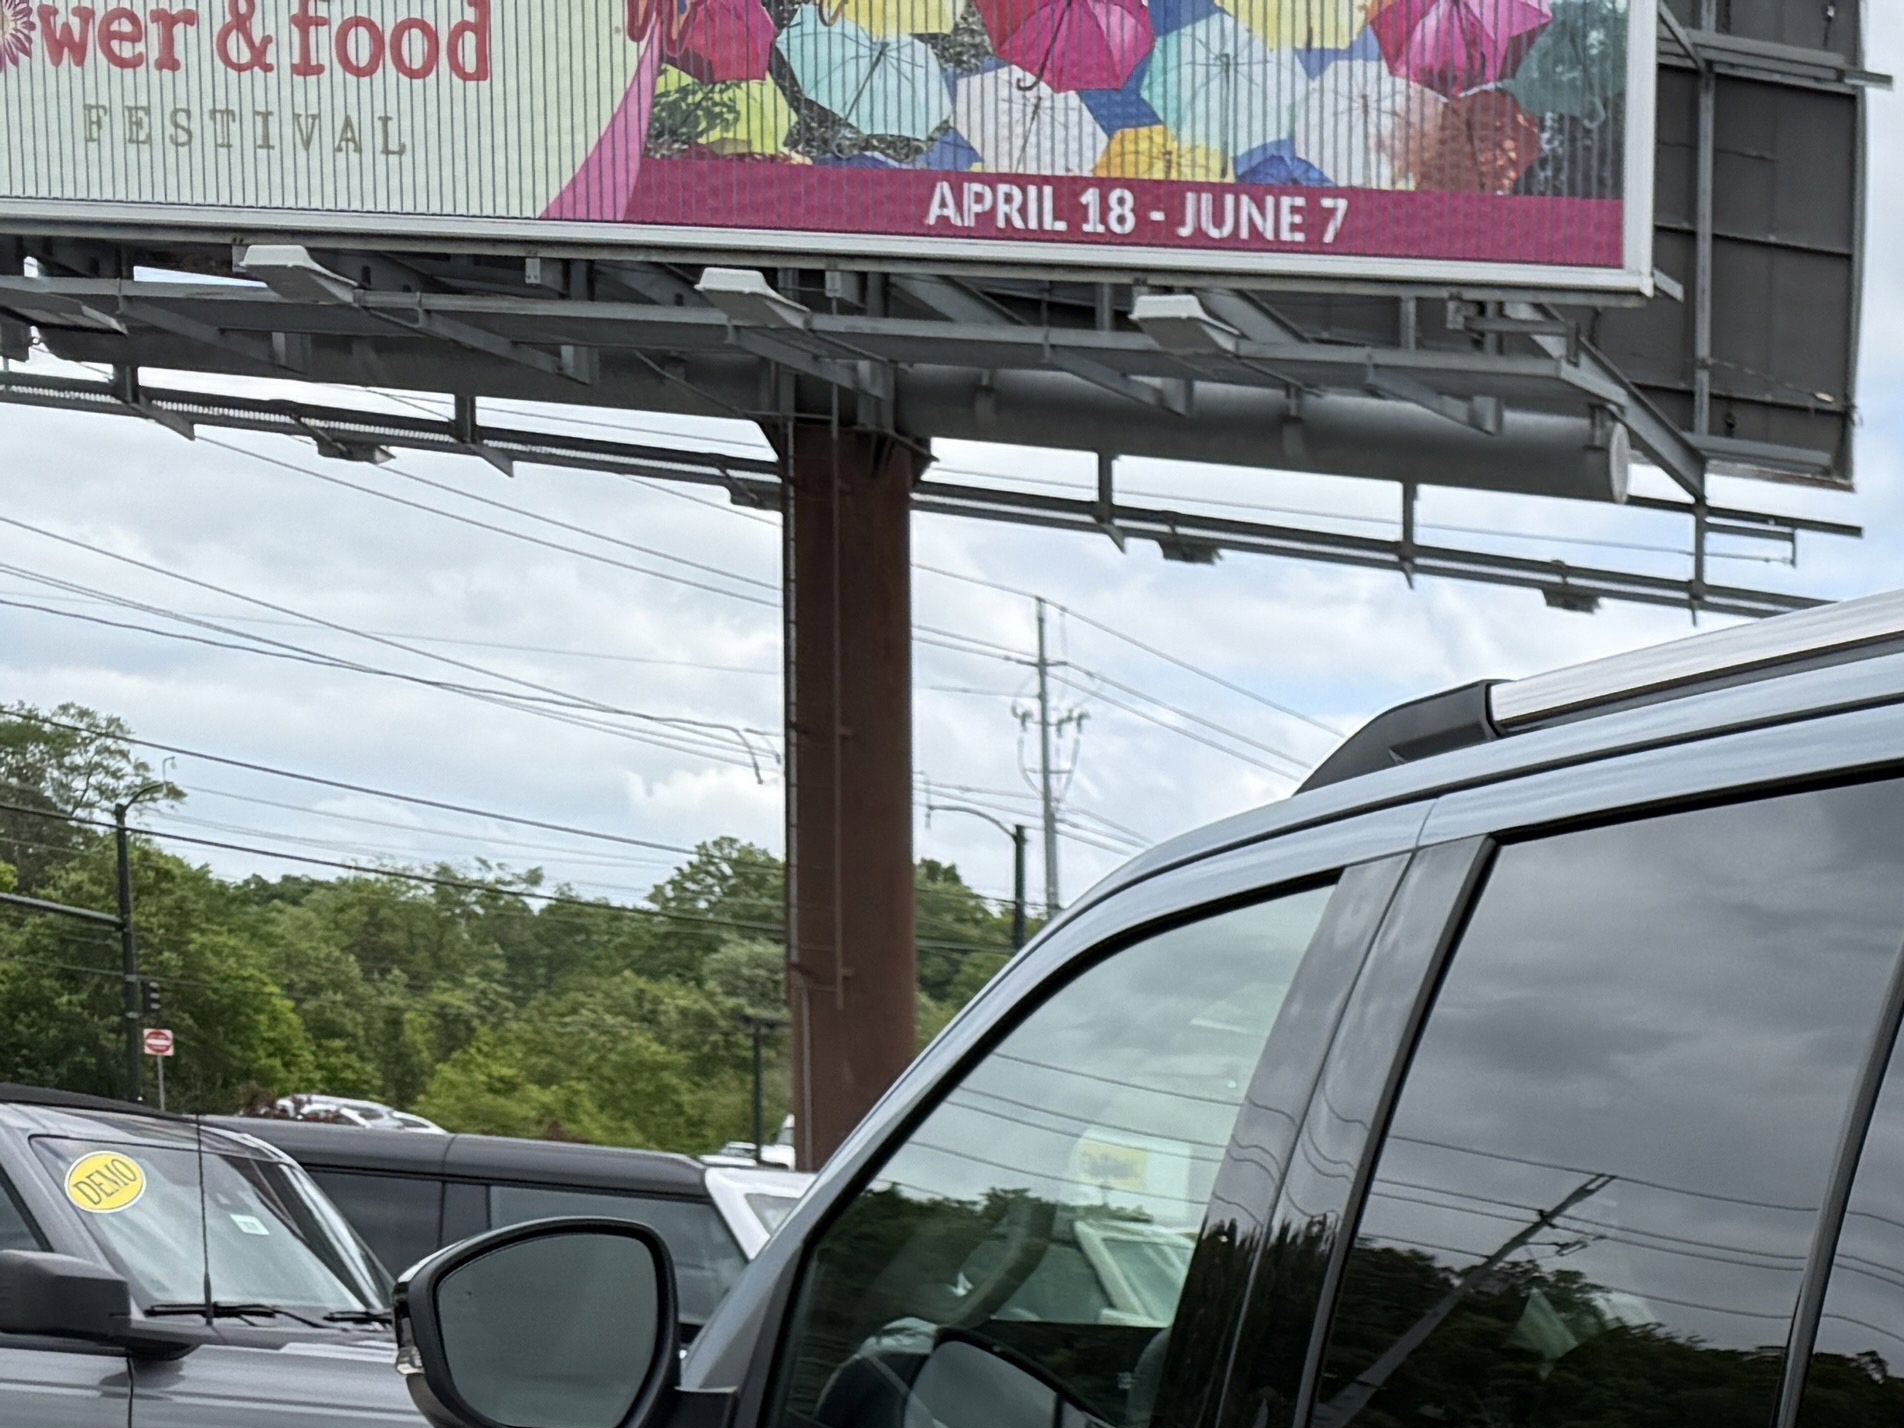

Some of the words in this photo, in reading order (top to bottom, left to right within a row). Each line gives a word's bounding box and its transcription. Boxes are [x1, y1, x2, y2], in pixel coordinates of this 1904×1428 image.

[37, 4, 198, 71] wer
[216, 0, 274, 72] &
[290, 0, 491, 81] food
[83, 104, 406, 156] FESTIVAL
[925, 181, 1067, 232] APRIL
[1079, 187, 1136, 234] 18
[1177, 191, 1306, 242] JUNE
[1320, 198, 1349, 244] 7
[72, 1159, 137, 1206] DEMO
